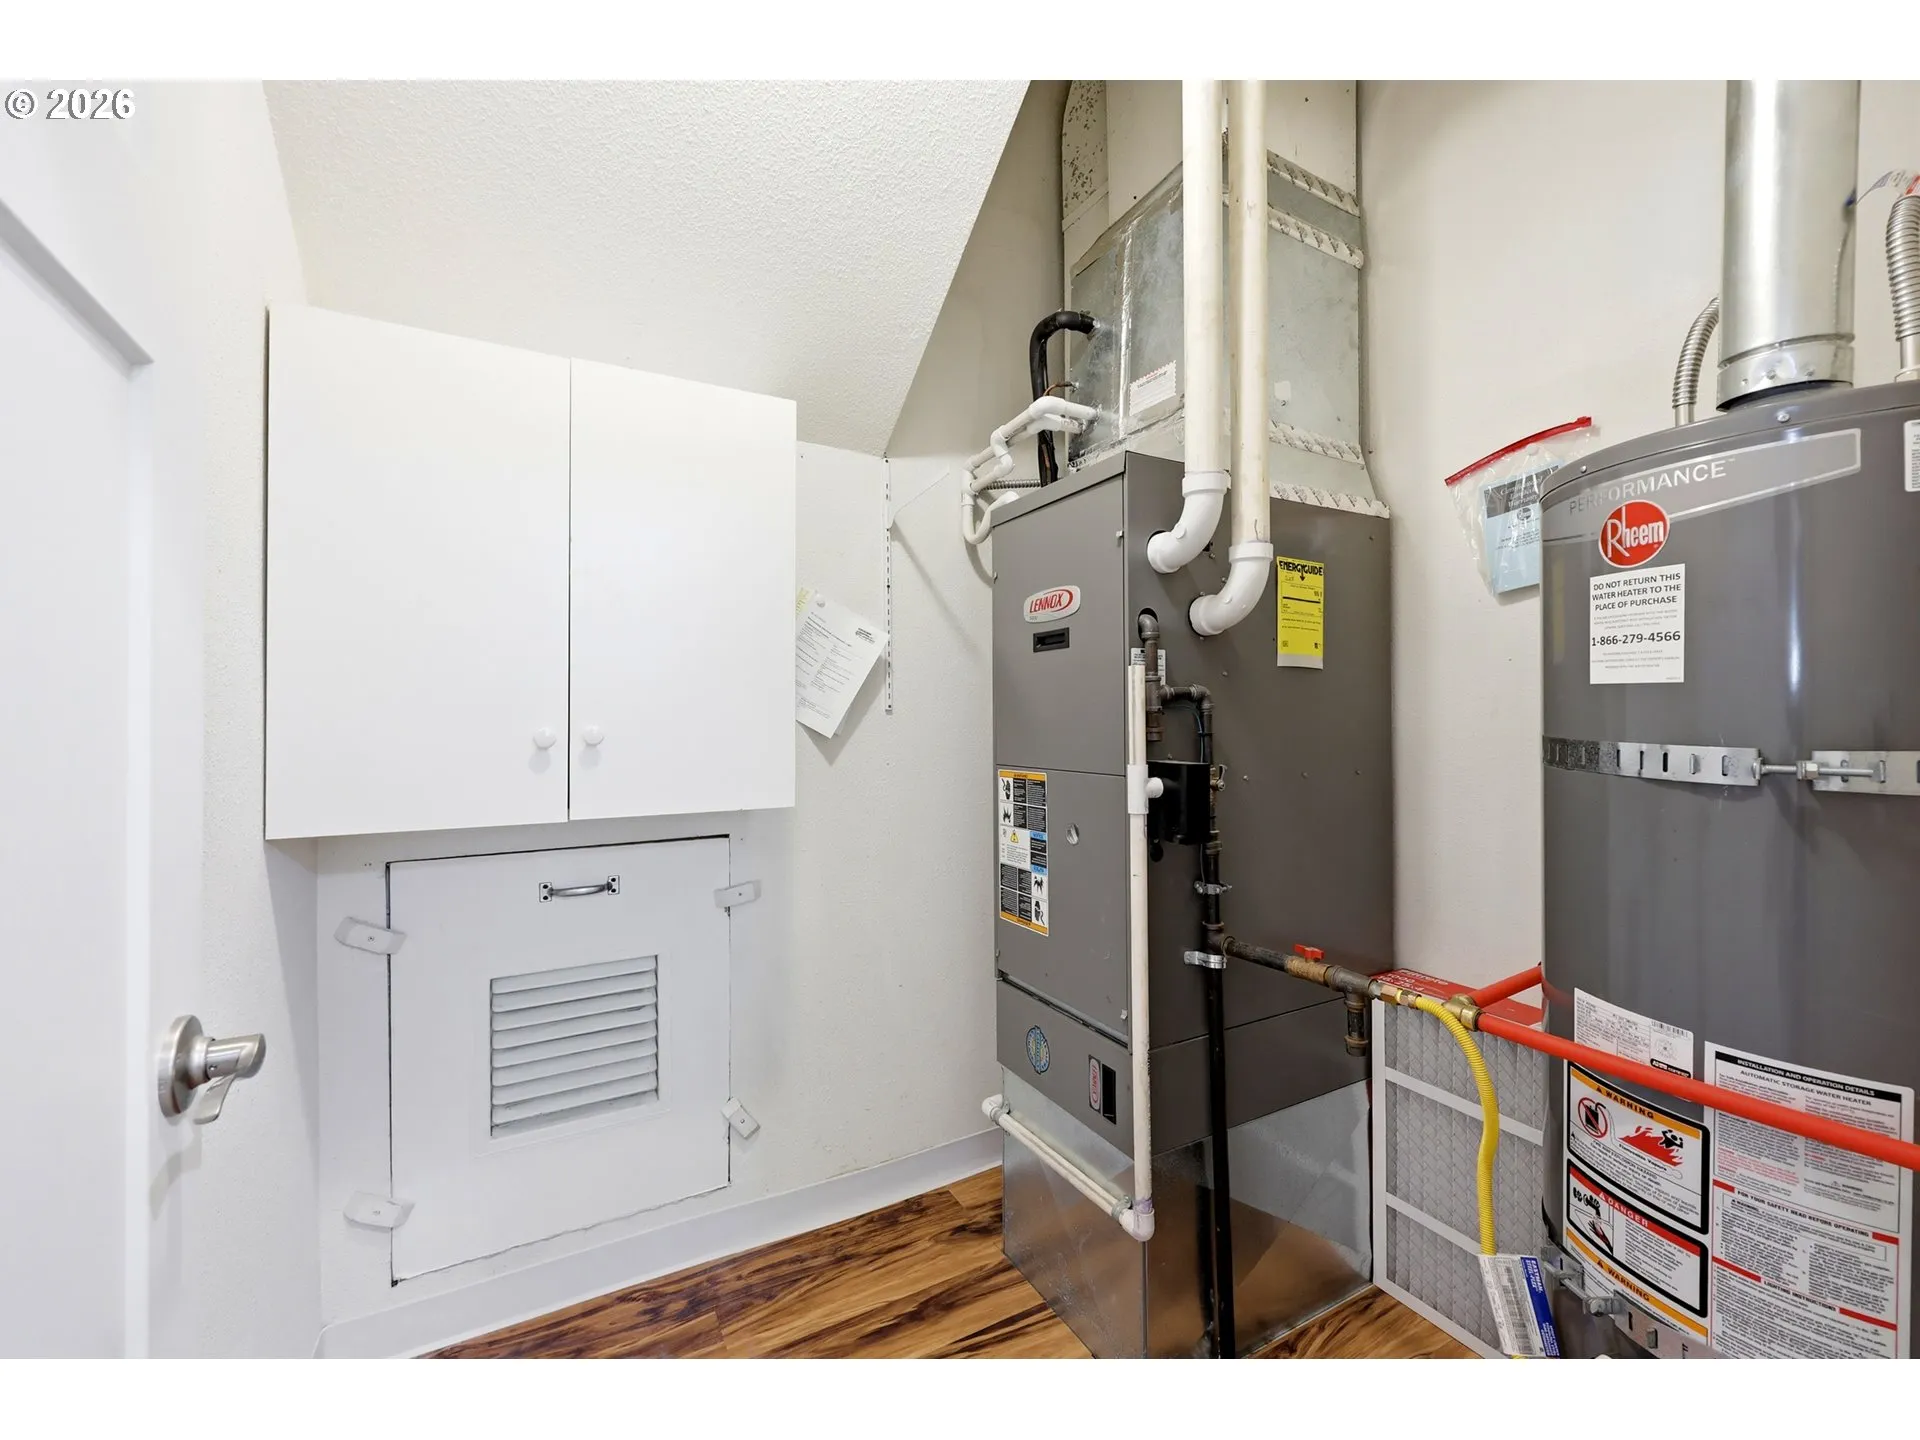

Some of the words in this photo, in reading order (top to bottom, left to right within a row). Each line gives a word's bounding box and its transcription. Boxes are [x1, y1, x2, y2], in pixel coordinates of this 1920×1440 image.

[1569, 460, 1727, 515] PERFORMANCE
[1606, 506, 1665, 558] Rheem
[1592, 591, 1616, 601] WATER
[1617, 587, 1648, 598] HEATER
[1650, 585, 1662, 594] TO
[1664, 583, 1682, 592] THE
[1593, 583, 1604, 591] DO
[1605, 580, 1621, 589] NOT
[1623, 575, 1657, 586] RETURN
[1660, 572, 1681, 582] THIS
[1030, 592, 1064, 613] LENNOX
[1595, 601, 1616, 611] PLACE
[1617, 600, 1629, 609] OF
[1630, 595, 1677, 607] PURCHASE
[1592, 630, 1681, 647] 1-866-279-4566
[1737, 1059, 1785, 1077] INSTALLATION
[1785, 1071, 1802, 1080] AND
[1802, 1074, 1844, 1090] OPERATION
[1845, 1085, 1875, 1097] DETAILS
[1740, 1070, 1781, 1085] AUTOMATIC
[1782, 1081, 1816, 1094] STORAGE
[1815, 1089, 1842, 1100] WATER
[1843, 1095, 1872, 1106] HEATER
[1606, 1091, 1655, 1119] WARNING
[1608, 1197, 1649, 1228] DANGER
[1737, 1190, 1750, 1199] FOR
[1750, 1194, 1766, 1205] YOUR
[1767, 1201, 1789, 1213] SAFETY
[1790, 1209, 1807, 1219] READ
[1808, 1215, 1833, 1227] BEFORE
[1834, 1222, 1869, 1237] OPERATING
[1607, 1265, 1651, 1302] WARNING
[1763, 1280, 1791, 1295] LIGHTING
[1791, 1291, 1837, 1312] INSTRUCTIONS
